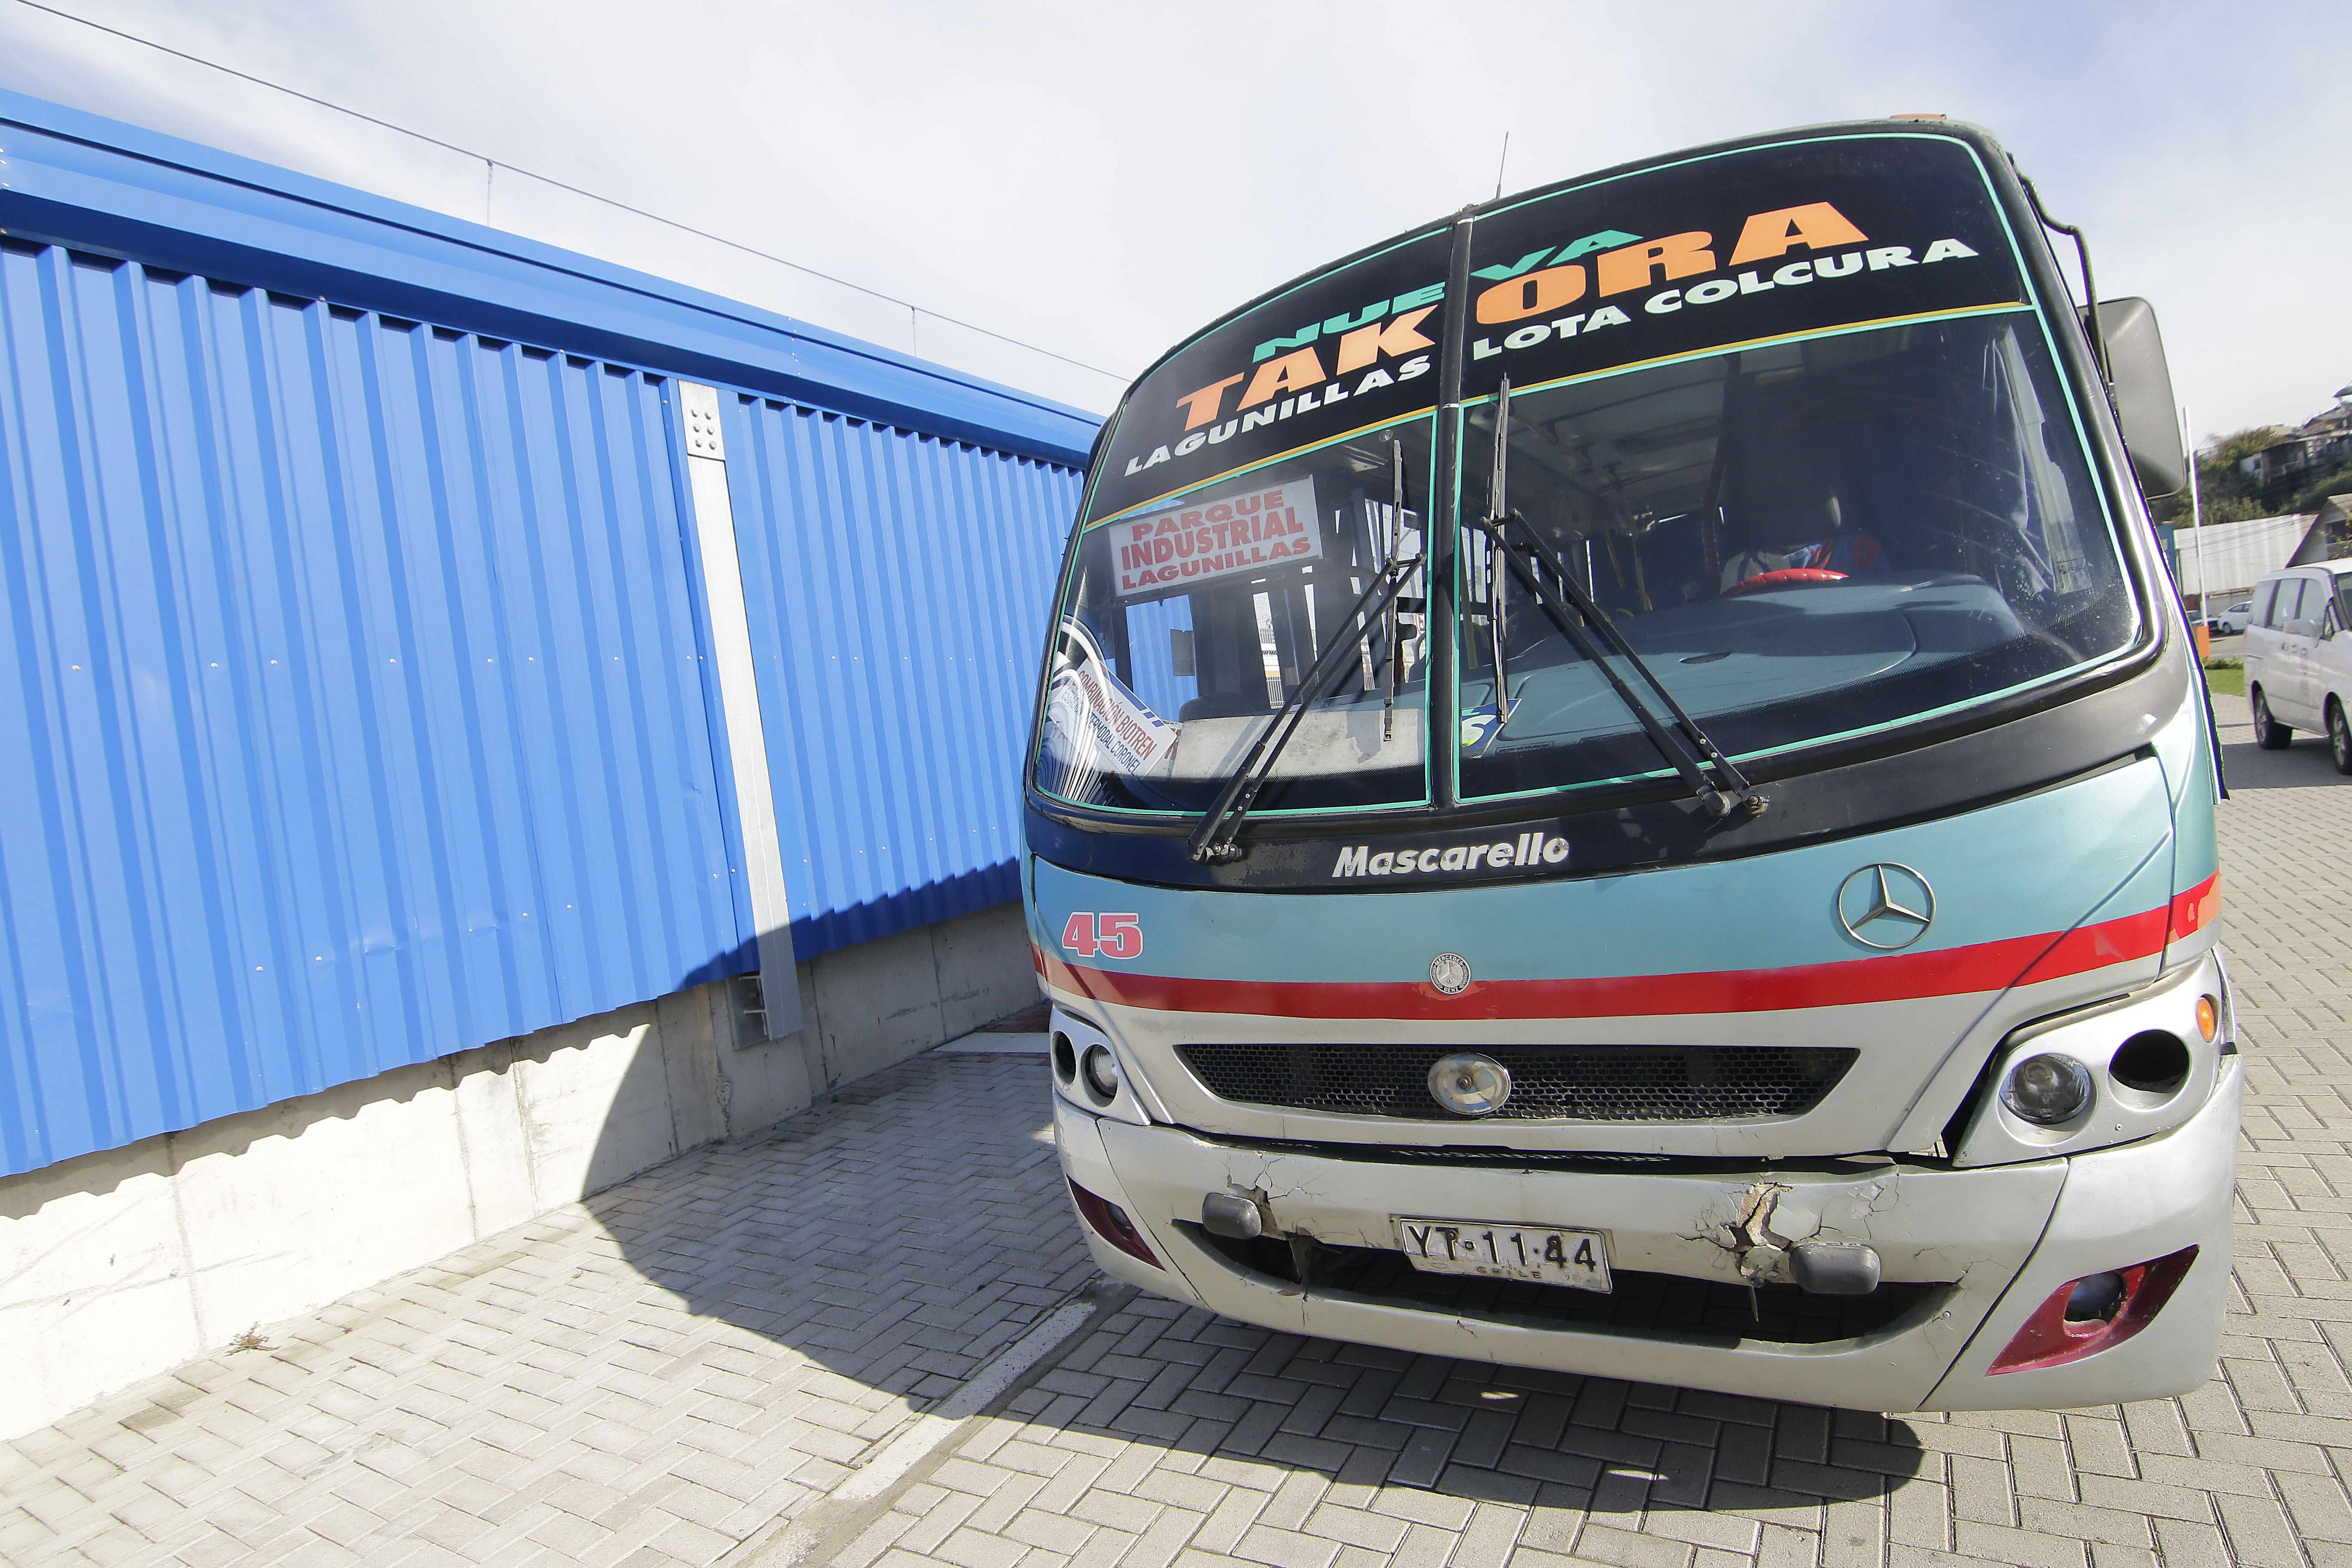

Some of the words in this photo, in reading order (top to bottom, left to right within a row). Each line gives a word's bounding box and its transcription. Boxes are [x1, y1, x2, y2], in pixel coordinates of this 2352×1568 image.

[1176, 201, 1869, 431] TAKORA
[1124, 355, 1431, 477] LAGUNILLAS
[1473, 305, 1631, 361] LOTA
[1645, 238, 1979, 315] COLCURA
[1121, 507, 1304, 570] INDUSTRIAL
[1132, 490, 1284, 542] PARQUE
[1122, 536, 1311, 590] LAGUNILLAS
[1110, 741, 1141, 774] CORONEL
[1115, 715, 1158, 761] BIOTREN
[1332, 832, 1570, 878] Mascarello
[1062, 912, 1143, 959] 45
[1434, 955, 1464, 966] MERCEDES
[1476, 1266, 1542, 1279] CHILE
